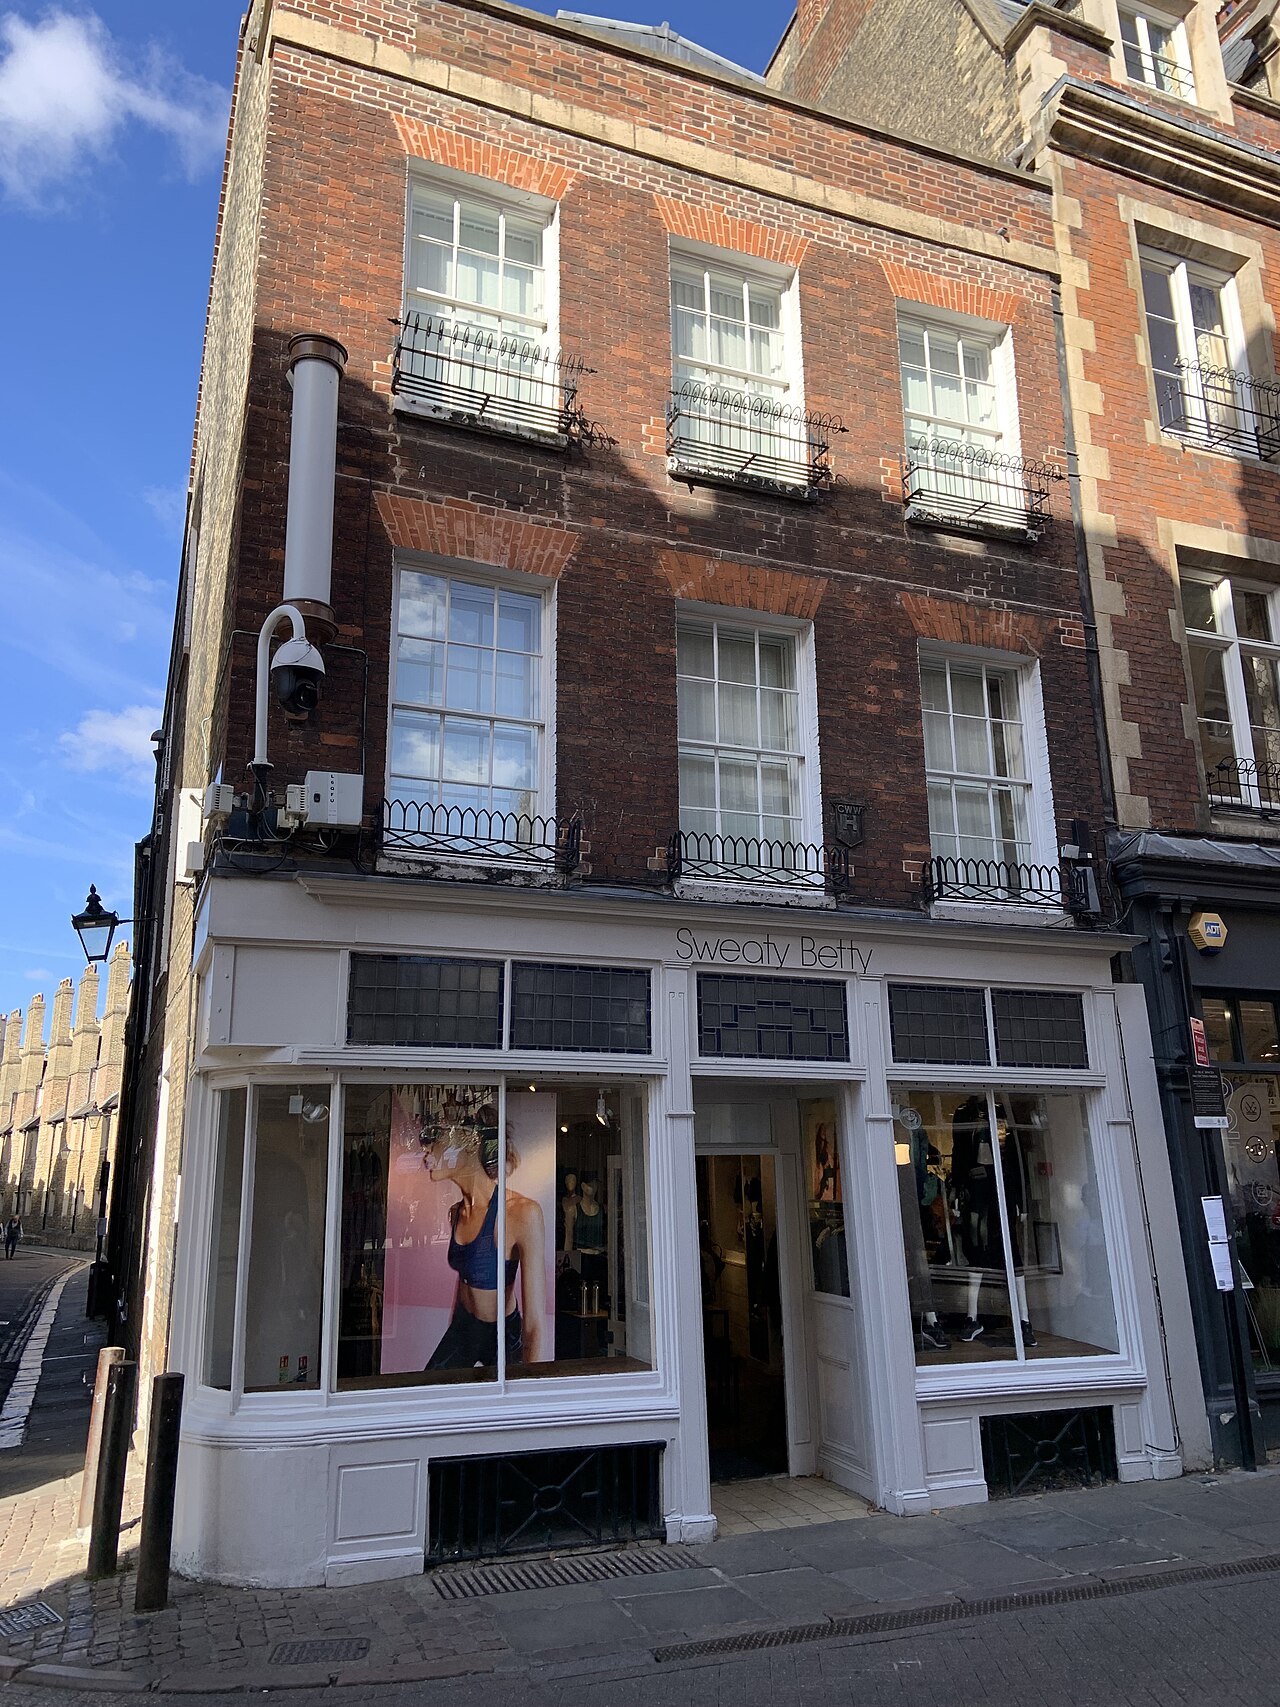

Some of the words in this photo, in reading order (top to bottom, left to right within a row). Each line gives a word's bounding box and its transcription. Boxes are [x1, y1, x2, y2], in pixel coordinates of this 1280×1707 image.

[1206, 925, 1220, 935] ADT
[676, 927, 790, 970] Sweaty
[801, 935, 873, 974] Betty
